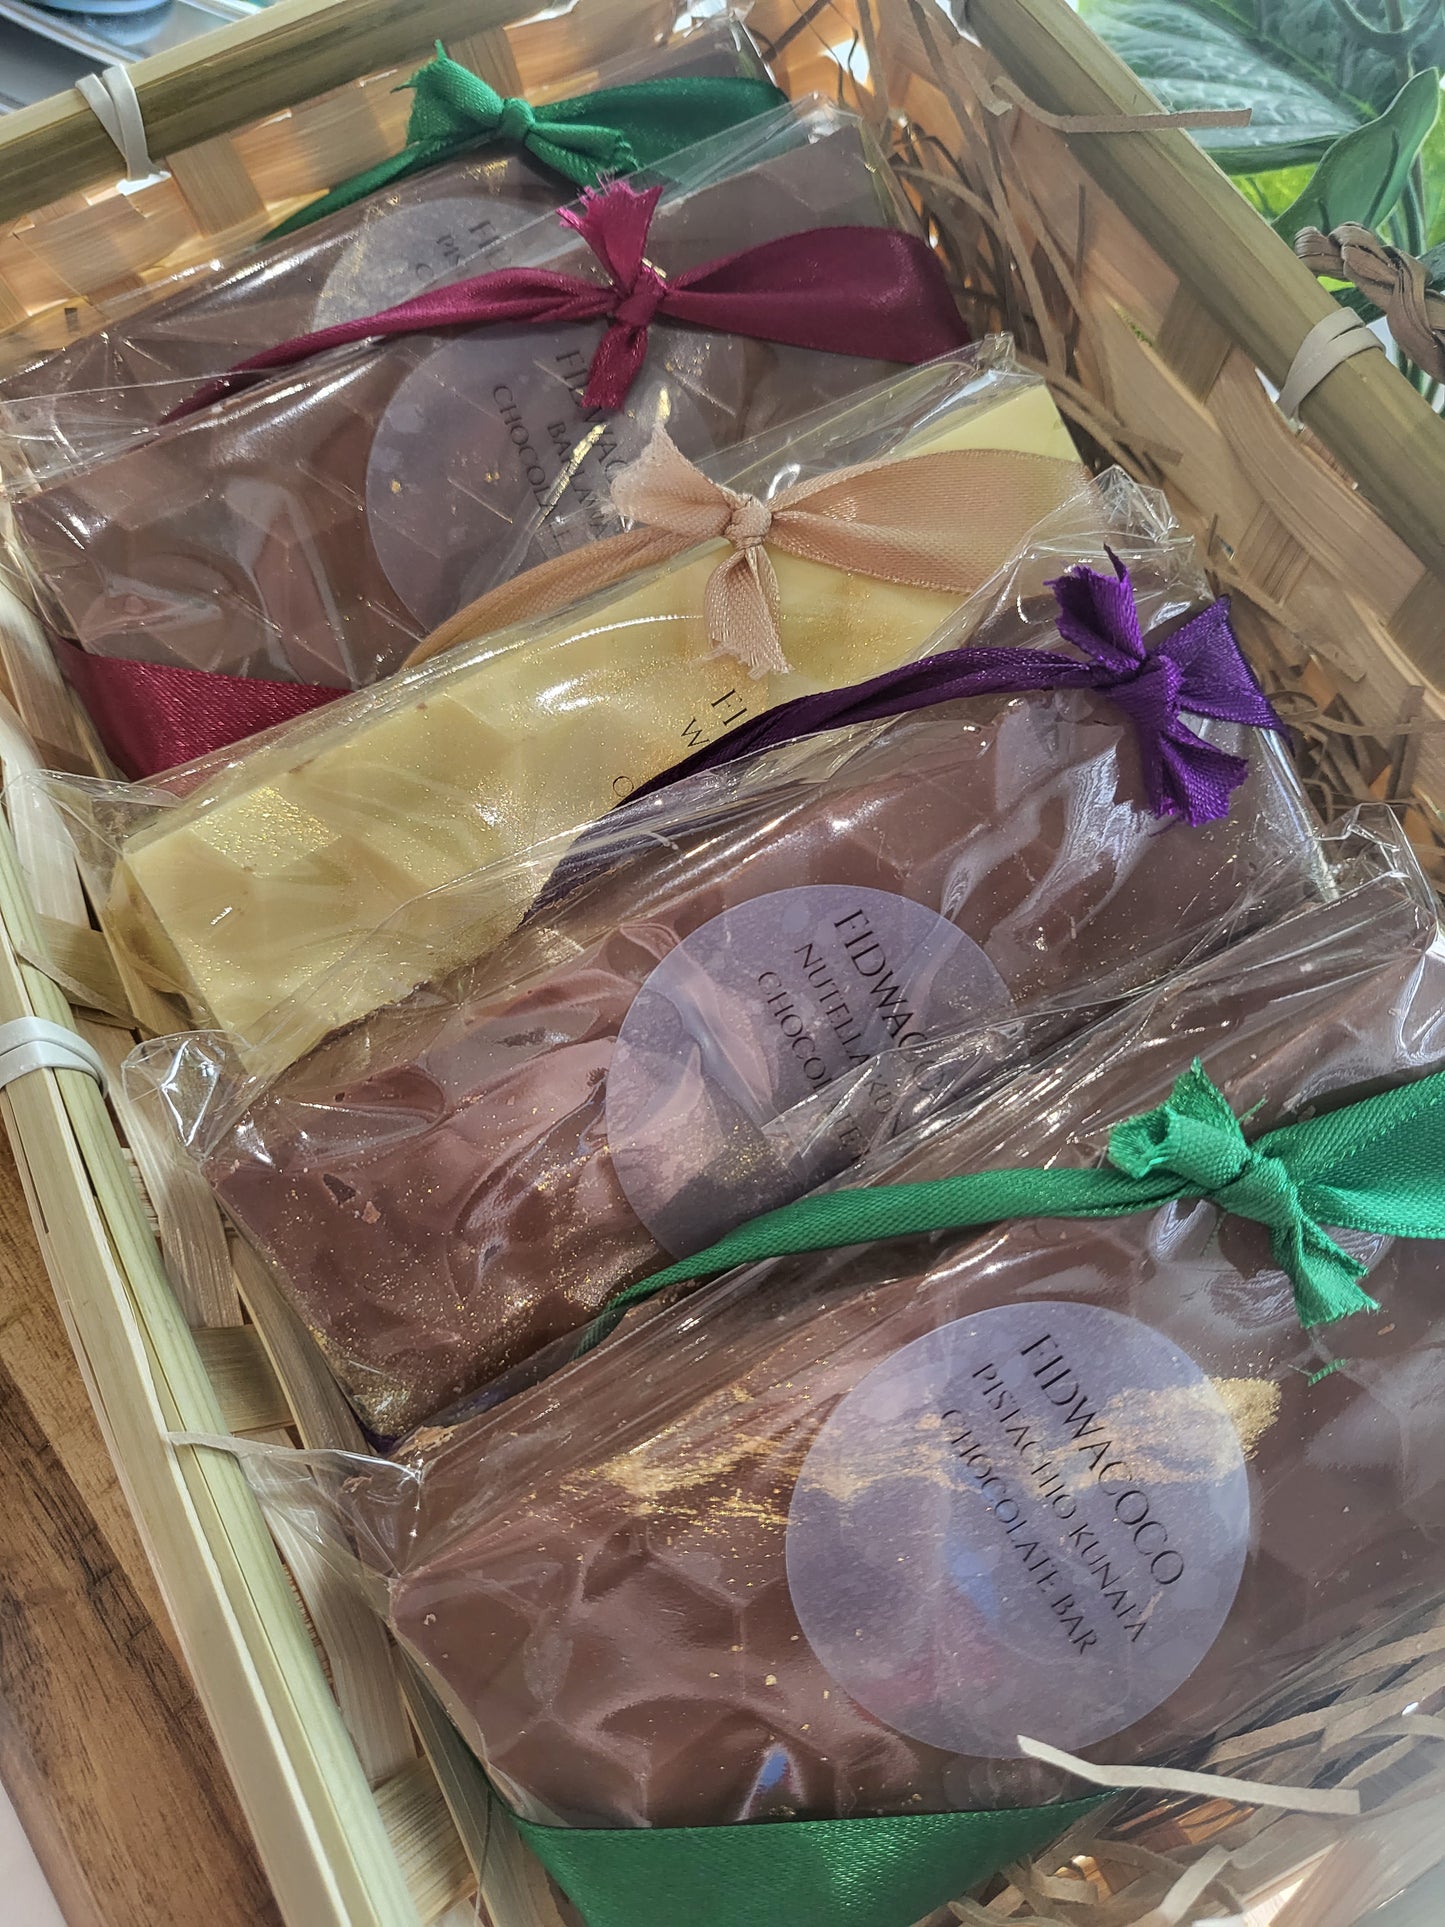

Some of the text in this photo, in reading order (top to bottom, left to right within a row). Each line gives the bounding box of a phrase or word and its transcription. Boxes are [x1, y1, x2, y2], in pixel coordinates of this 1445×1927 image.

[941, 1409, 1097, 1655] CHOCOLATE BAR
[972, 1363, 1147, 1643] PISTACHIO KUNAFA
[1021, 1334, 1184, 1585] FIDWACOCO
